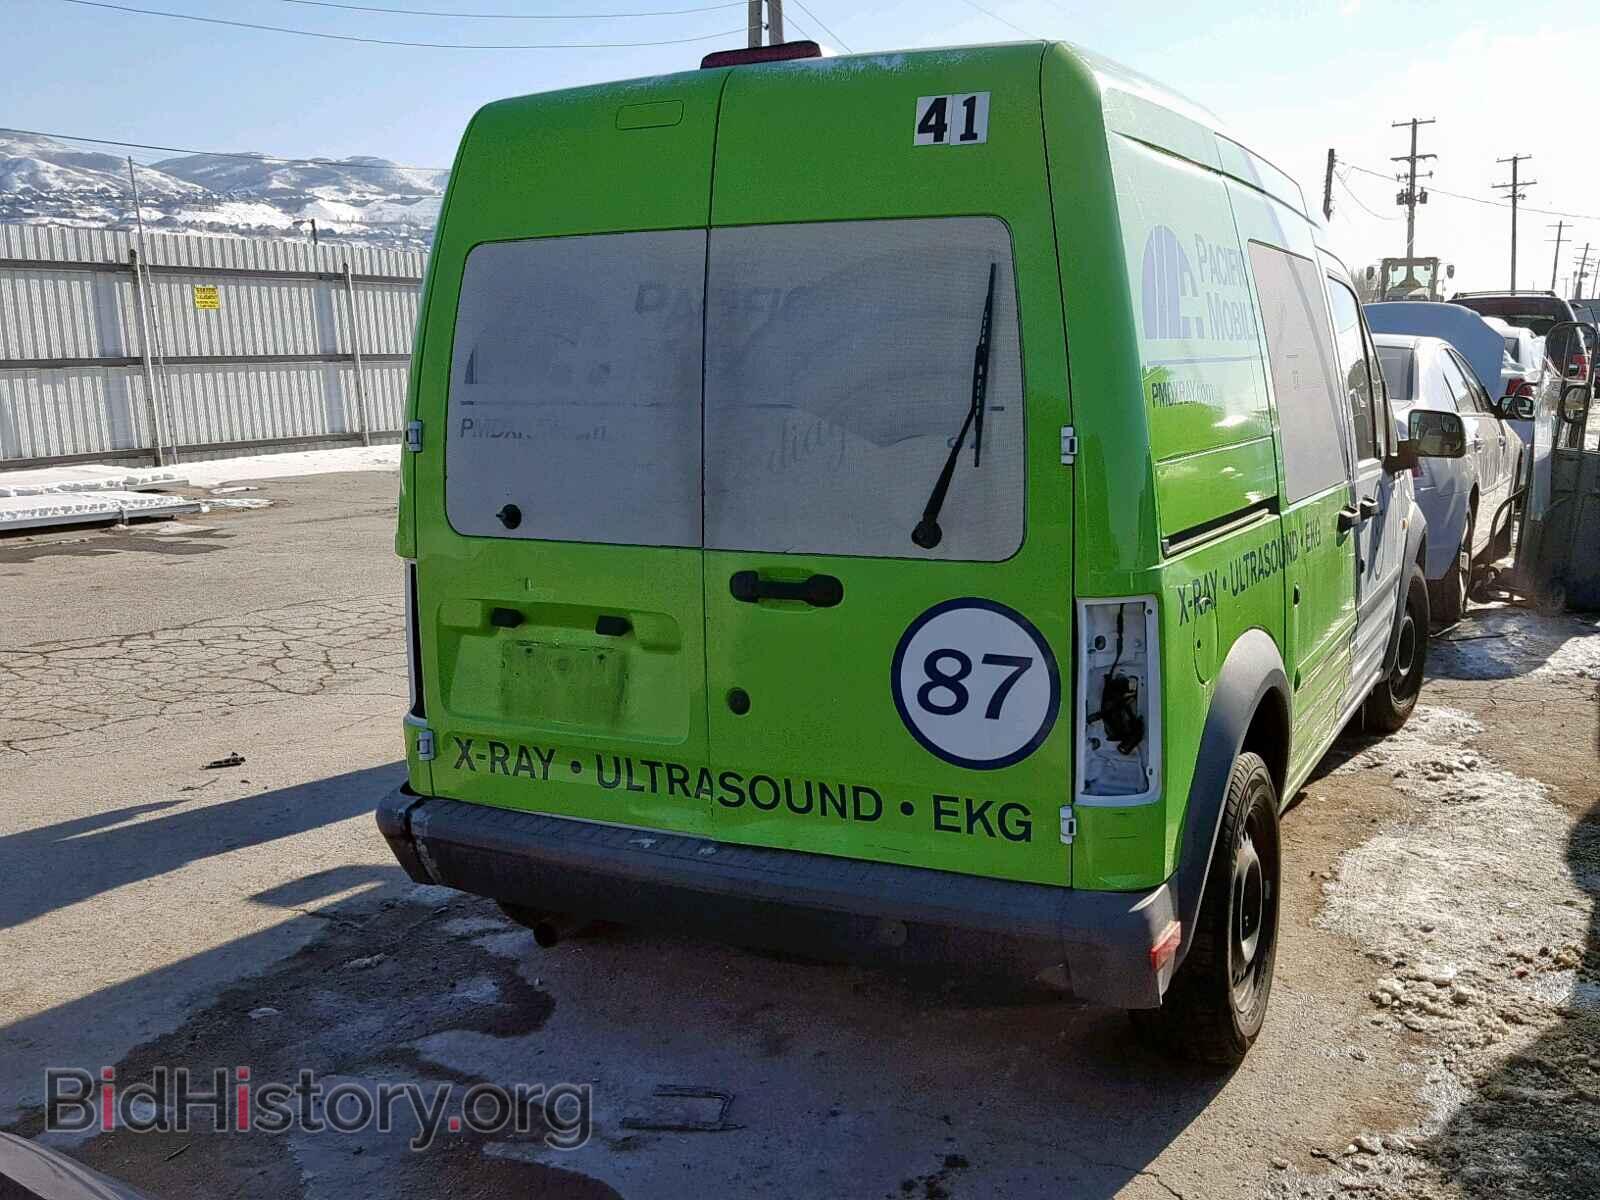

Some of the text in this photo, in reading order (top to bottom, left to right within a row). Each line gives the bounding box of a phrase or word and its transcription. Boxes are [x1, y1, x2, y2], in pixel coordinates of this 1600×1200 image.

[916, 96, 979, 143] 41
[1177, 518, 1322, 627] X-RAY ULTRASOUND EKG
[916, 647, 1034, 721] 87
[453, 735, 1033, 843] X-RAY ULTRASOUND EKG
